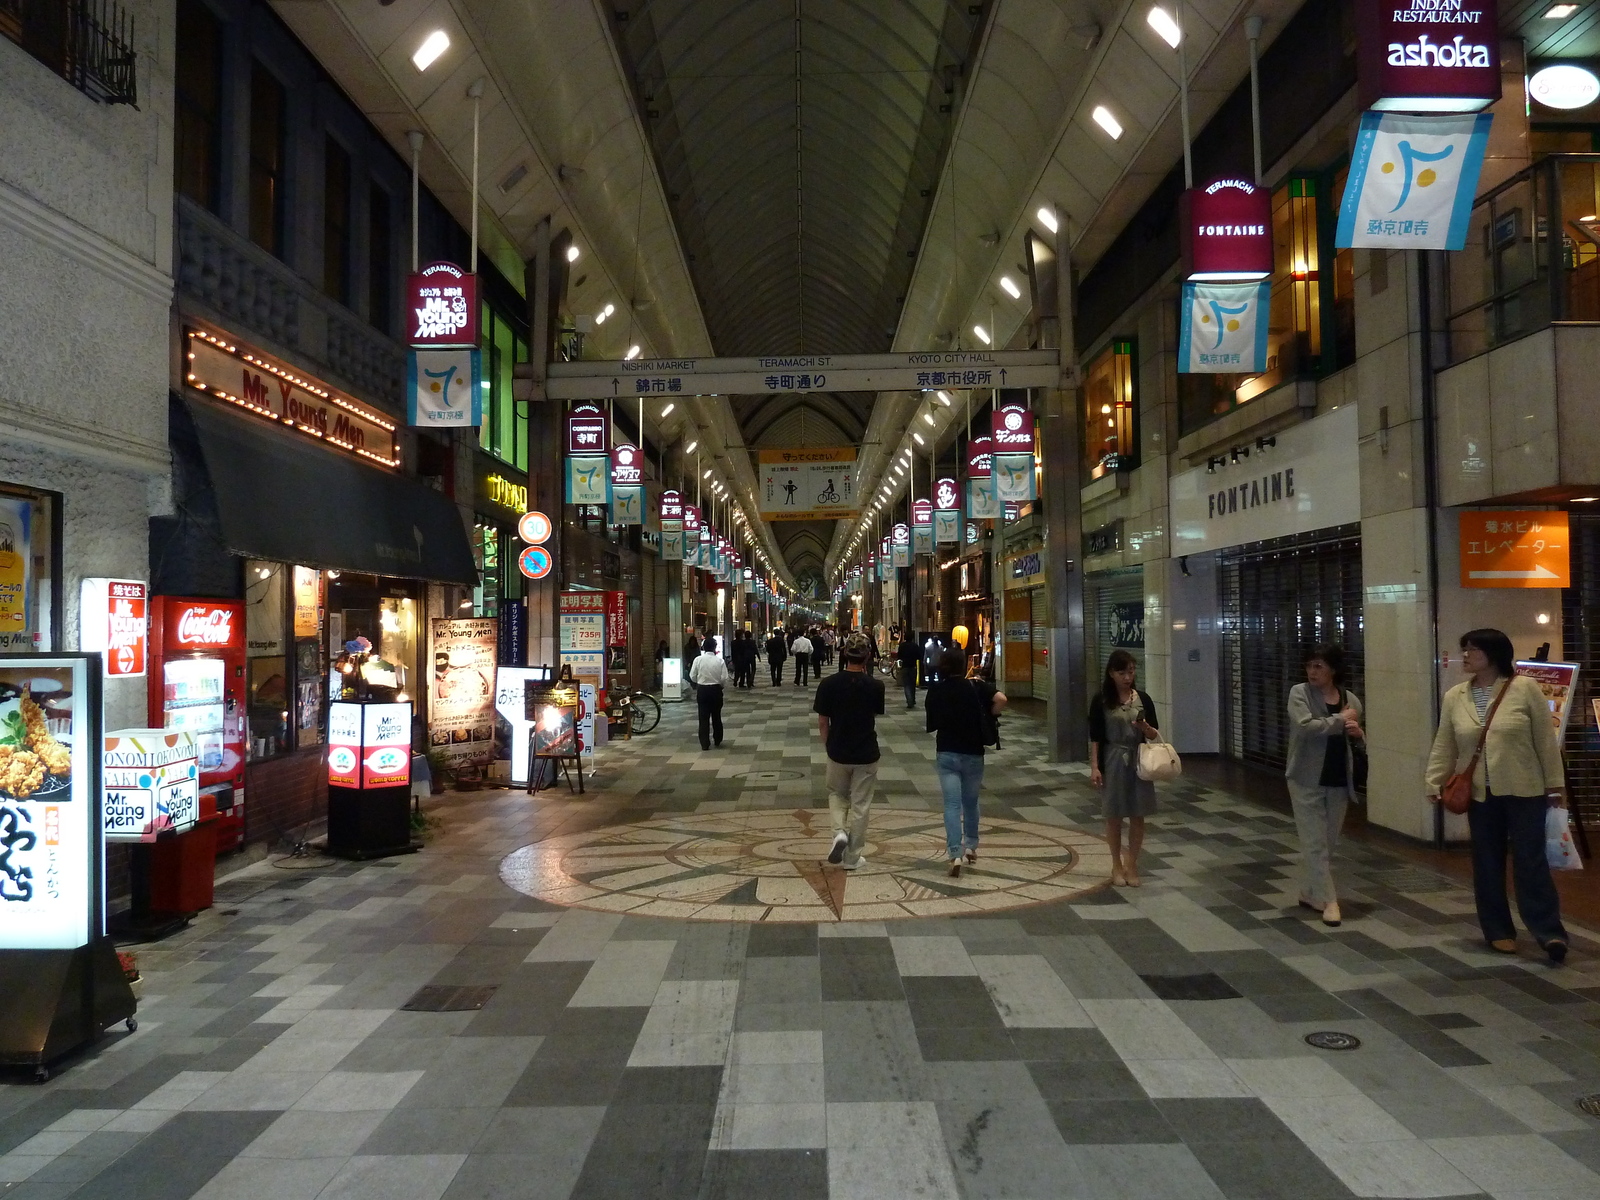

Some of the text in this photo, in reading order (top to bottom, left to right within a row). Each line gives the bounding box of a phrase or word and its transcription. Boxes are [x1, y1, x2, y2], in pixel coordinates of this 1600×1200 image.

[1411, 0, 1461, 10] INDIAN
[1393, 10, 1482, 23] RESTAURANT
[1387, 35, 1490, 67] ashoka
[1205, 179, 1255, 196] TERAMACHI
[1198, 225, 1265, 236] FONTAINE
[422, 264, 462, 279] TERAMACHI
[426, 297, 450, 313] Mr.
[415, 308, 467, 328] Young
[414, 323, 457, 338] Men
[621, 361, 696, 371] NISHIKI MARKET
[759, 357, 834, 367] TERAMACHI ST.
[908, 353, 995, 364] KYOTO CITY HALL
[635, 378, 682, 393] 錦市場
[764, 375, 827, 389] 寺町通り
[916, 370, 992, 386] 京都市役所
[242, 369, 365, 447] Mr. Young Men
[428, 410, 464, 420] 寺町京極
[574, 404, 600, 413] TERAMACHI
[1208, 468, 1295, 519] FONTAINE
[526, 520, 544, 535] 30
[1485, 520, 1543, 534] 菊水ビル
[1467, 539, 1562, 554] エレベーター
[109, 612, 145, 637] Young
[436, 629, 492, 639] Mr. Young Men
[511, 603, 519, 664] オリジナルポストカード
[157, 744, 198, 766] OKONOMI
[107, 793, 128, 805] Mr.
[165, 796, 192, 811] Young
[105, 804, 145, 820] oung
[46, 848, 59, 899] とんかつ
